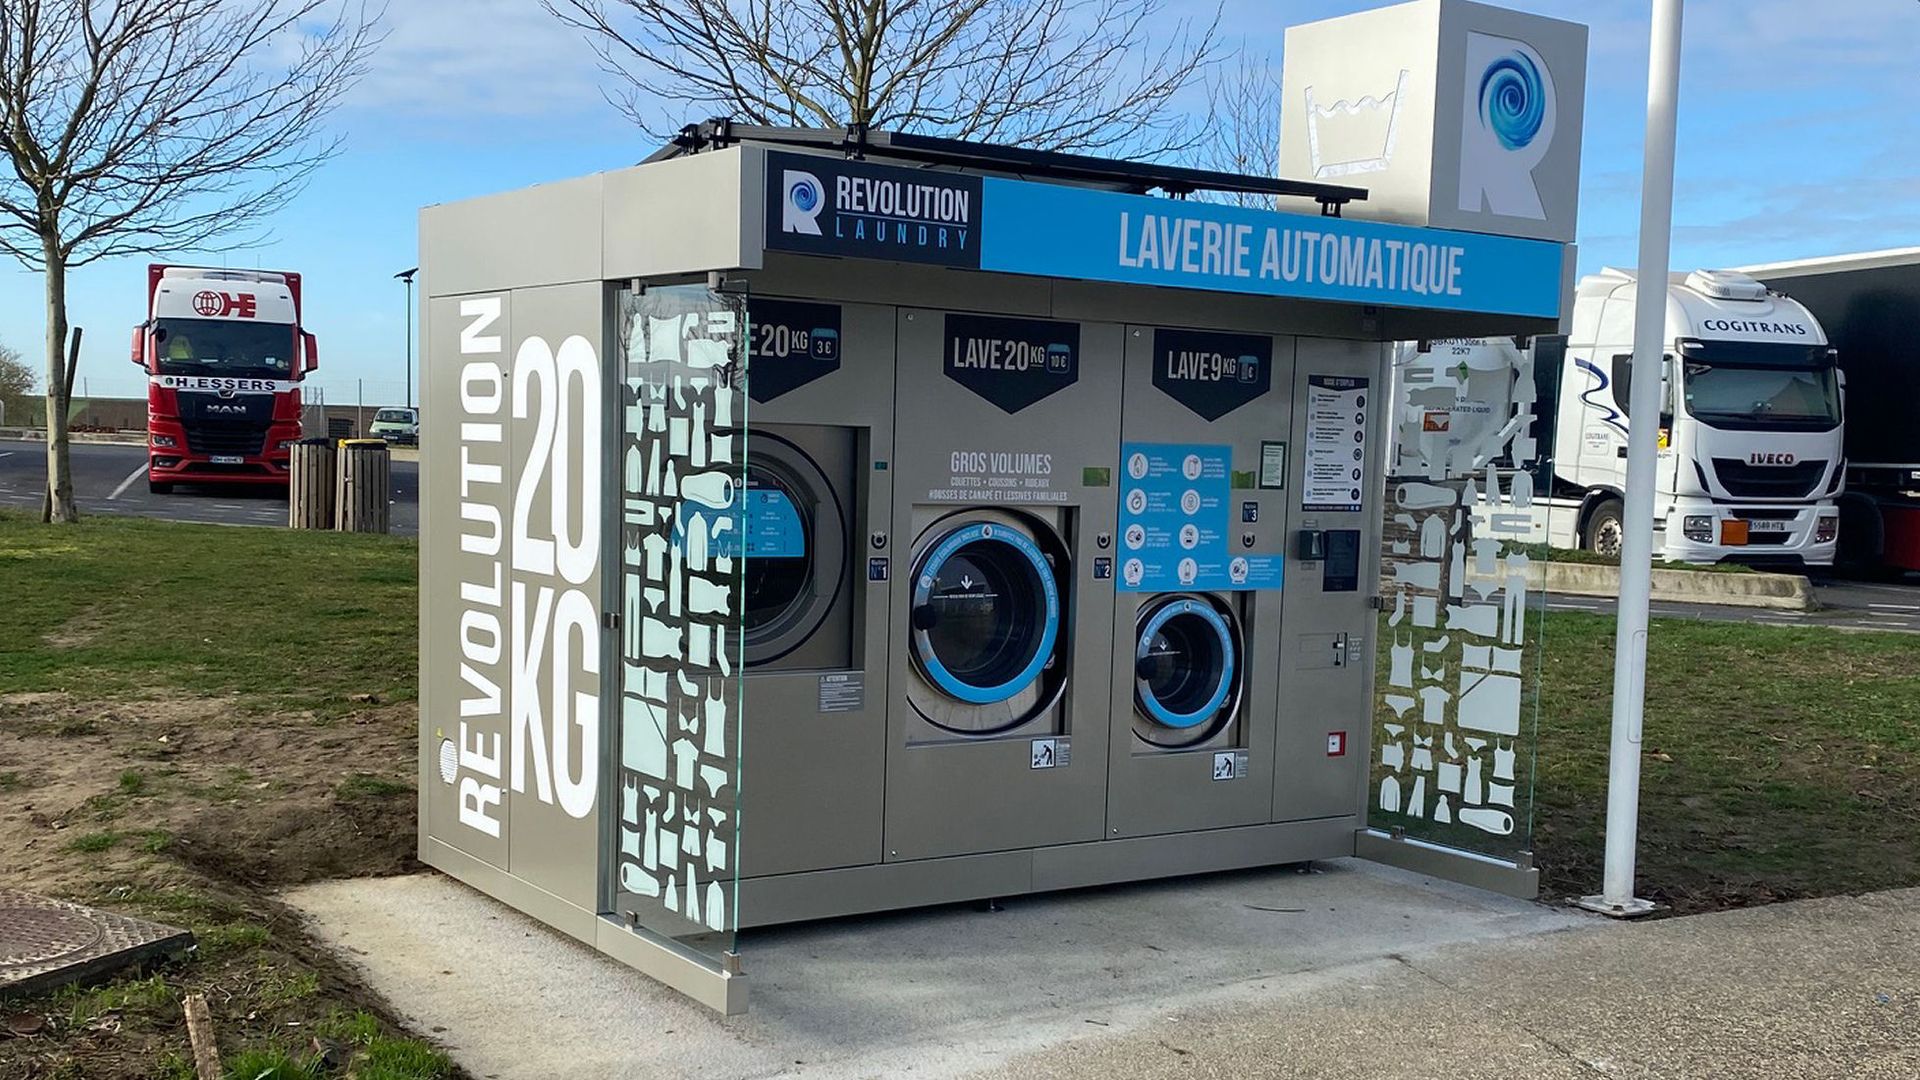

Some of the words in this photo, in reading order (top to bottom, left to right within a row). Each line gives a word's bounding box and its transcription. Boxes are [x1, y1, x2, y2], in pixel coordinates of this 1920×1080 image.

[837, 176, 969, 223] REVOLUTION
[836, 217, 968, 250] LAUNDRY
[1119, 212, 1253, 278] LAVERIE
[1260, 228, 1465, 296] AUTOMATIQUE
[760, 324, 790, 358] 20
[791, 330, 809, 350] KG
[1704, 319, 1807, 336] COGITRANS
[954, 337, 1002, 369] LAVE
[1004, 340, 1029, 371] 20
[1030, 345, 1045, 364] KG
[1168, 350, 1210, 380] LAVE
[1210, 352, 1222, 381] 9
[1222, 358, 1237, 374] KG
[176, 377, 276, 391] H.ESSERS
[206, 404, 247, 415] MAN
[511, 334, 602, 585] 20
[951, 452, 987, 473] GROS
[990, 453, 1052, 475] VOLUMES
[1750, 453, 1794, 465] IVECO
[950, 477, 982, 488] COUETTES
[460, 297, 503, 838] REVOLUTION
[511, 580, 600, 819] KG
